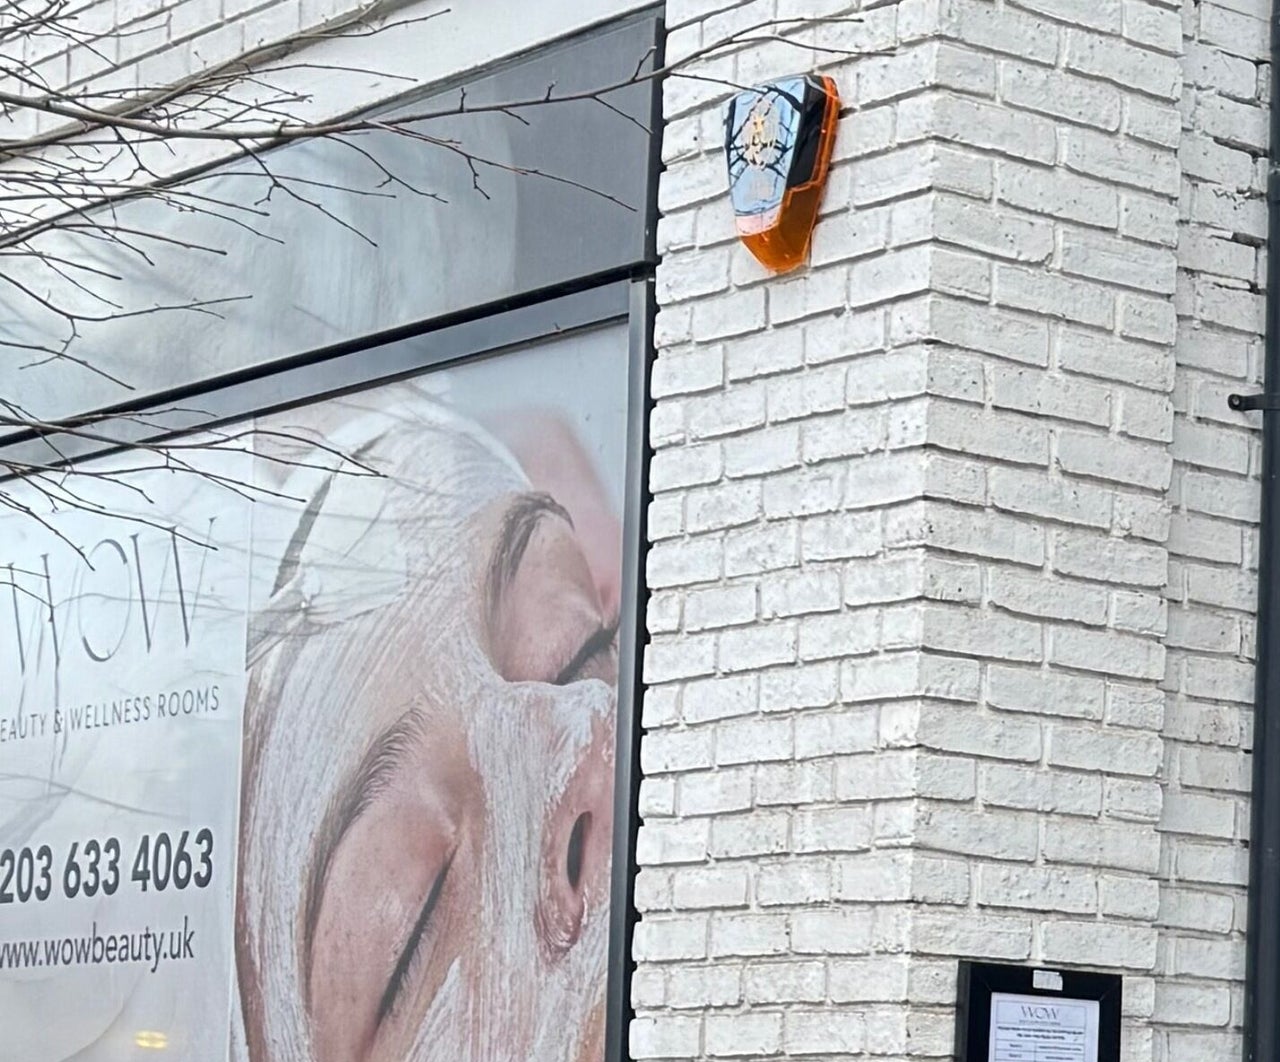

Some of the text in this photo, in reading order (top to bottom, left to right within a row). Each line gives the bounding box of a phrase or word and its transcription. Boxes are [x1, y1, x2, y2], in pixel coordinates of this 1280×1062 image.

[7, 516, 217, 676] WOW
[53, 709, 62, 734] &
[70, 696, 151, 731] WELLNESS
[157, 685, 220, 718] ROOMS
[63, 837, 121, 899] 633
[131, 828, 214, 892] 4063
